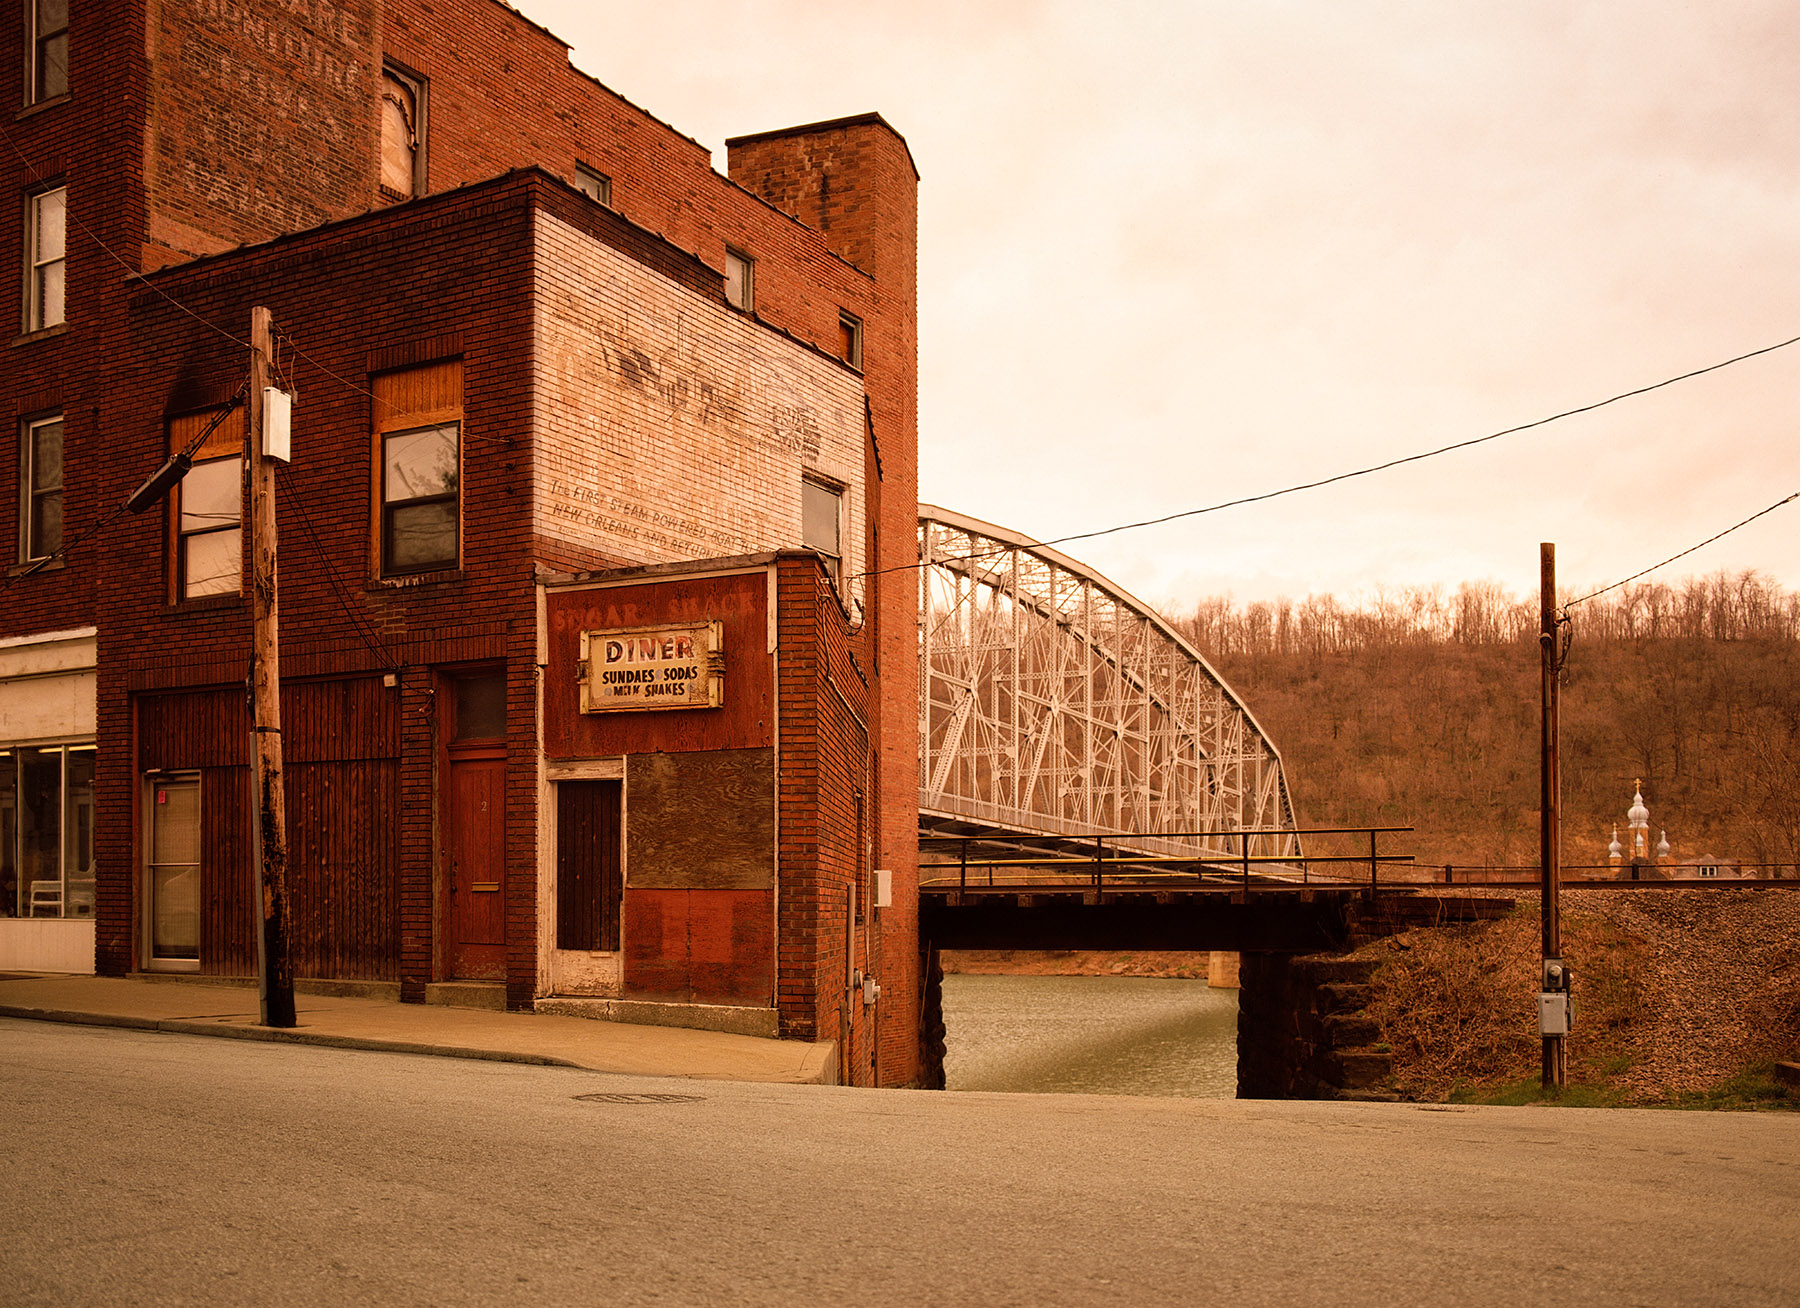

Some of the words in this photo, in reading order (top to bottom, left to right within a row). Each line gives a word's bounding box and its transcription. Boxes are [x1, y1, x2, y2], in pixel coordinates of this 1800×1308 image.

[553, 503, 582, 521] NEW
[585, 512, 639, 539] ORLEANS
[643, 530, 667, 547] AND
[574, 486, 607, 505] FIRST
[610, 498, 648, 519] STEAM
[653, 512, 707, 538] POWERED
[605, 635, 695, 664] DINER
[602, 669, 655, 685] SUNDAES
[663, 666, 698, 681] SODAS
[613, 684, 640, 697] MILK
[645, 682, 685, 697] SHAKES
